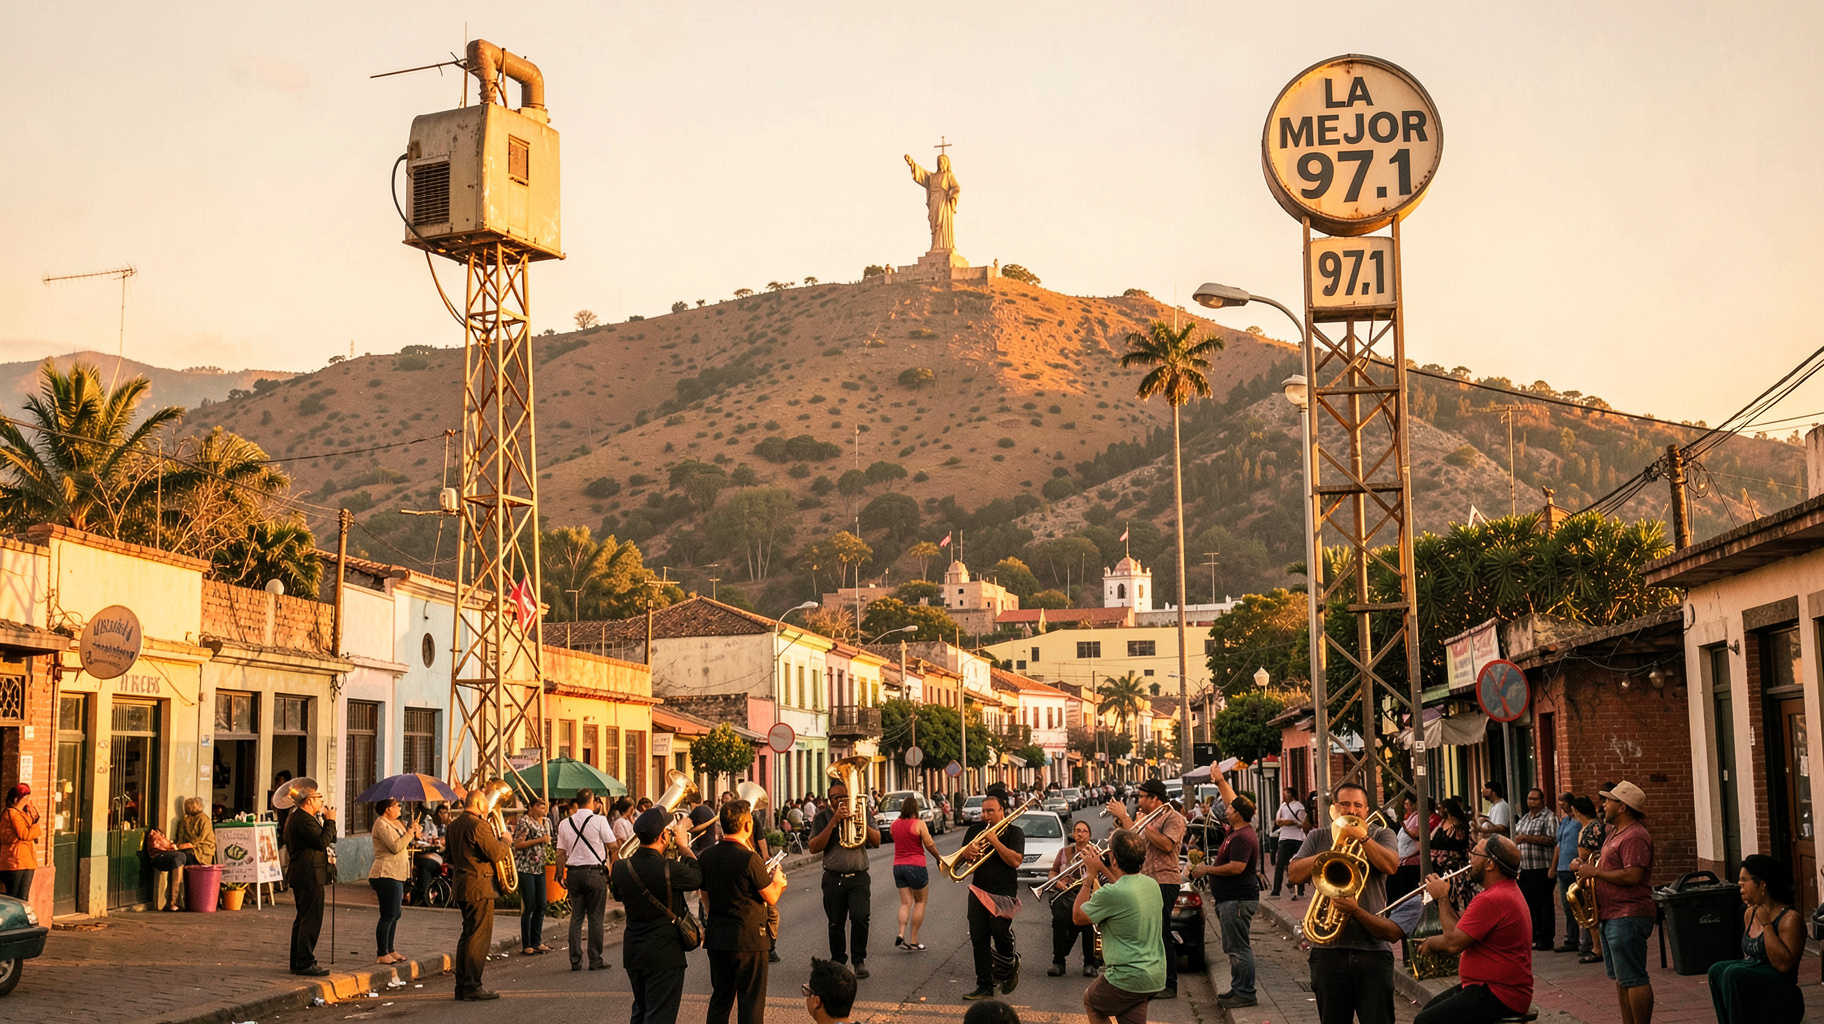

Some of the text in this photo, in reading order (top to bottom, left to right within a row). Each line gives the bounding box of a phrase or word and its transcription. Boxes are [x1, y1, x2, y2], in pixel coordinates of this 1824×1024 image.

[1325, 76, 1374, 109] LA
[1279, 110, 1429, 149] MEJOR
[1297, 148, 1413, 203] 97.1
[1318, 249, 1385, 297] 97.1
